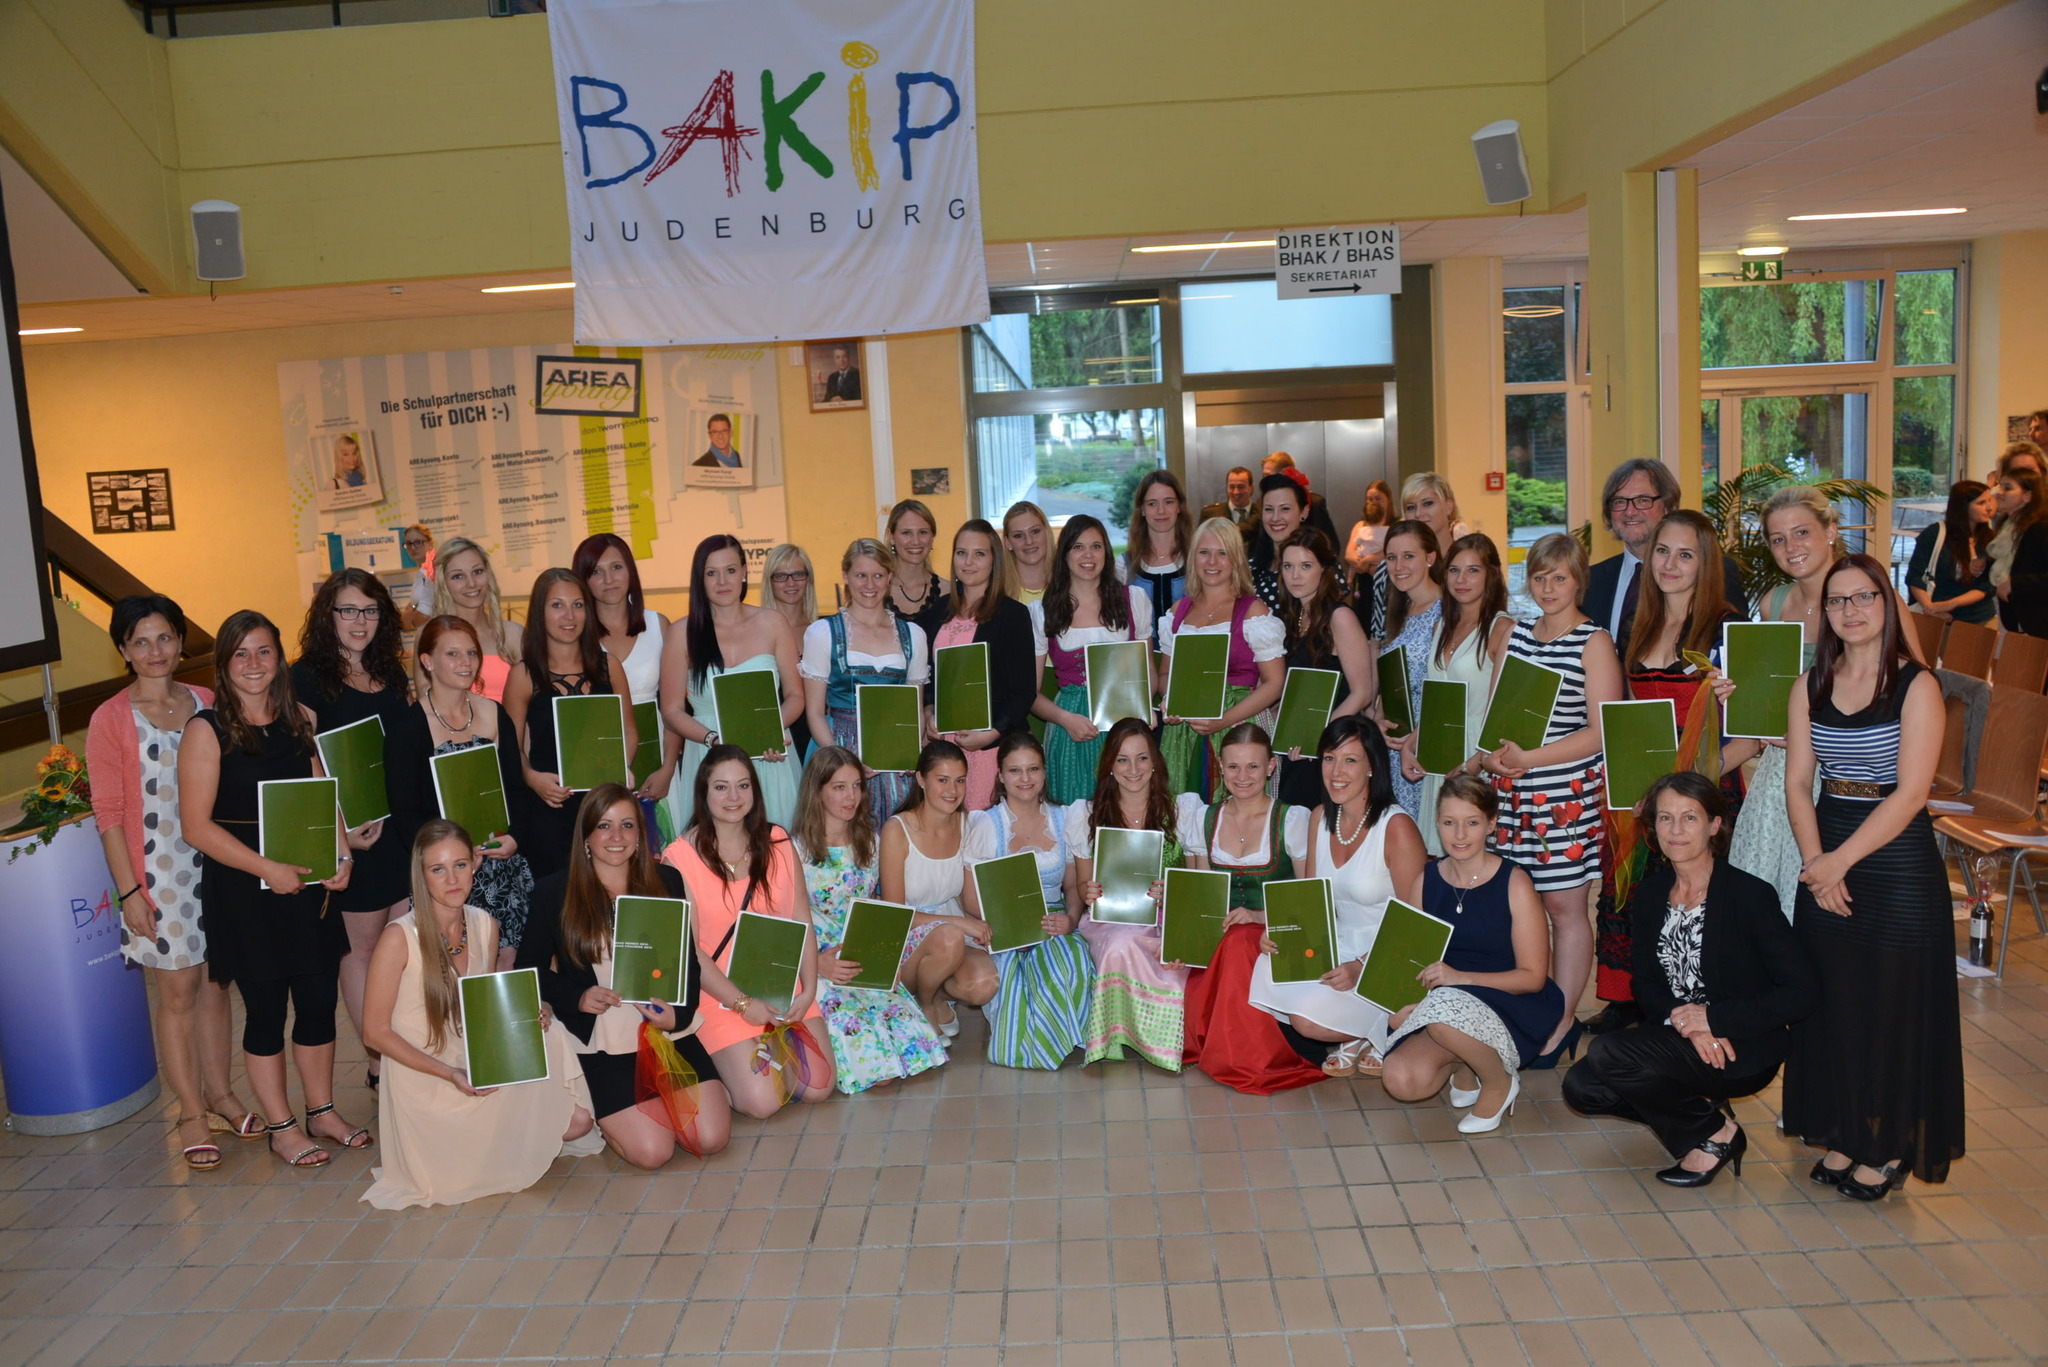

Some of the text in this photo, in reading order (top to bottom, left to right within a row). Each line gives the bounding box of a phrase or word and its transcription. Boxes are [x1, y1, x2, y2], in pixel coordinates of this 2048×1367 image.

[583, 199, 966, 242] JUDENBURG
[1279, 230, 1394, 249] DIREKTION
[1280, 246, 1395, 266] BHAK / BHAS
[1290, 269, 1378, 282] SEKRETARIAT
[546, 368, 631, 388] AREA
[380, 384, 517, 414] Die Schulpartnerschaft
[528, 384, 639, 411] young
[420, 412, 443, 429] für
[448, 405, 487, 425] DICH
[71, 888, 121, 929] BAK
